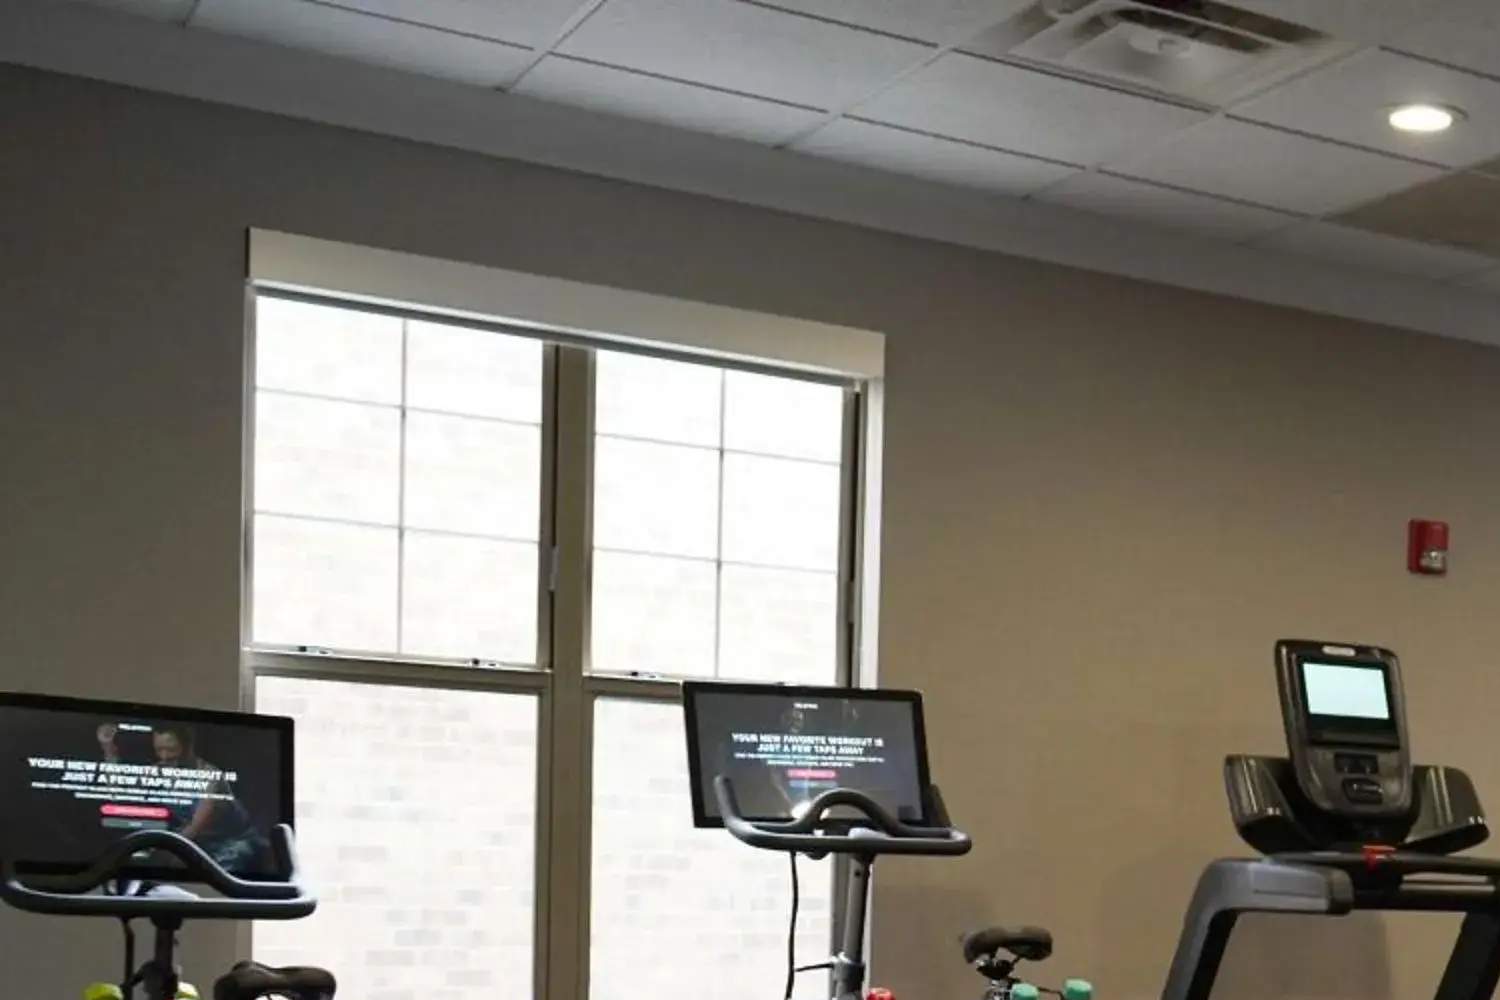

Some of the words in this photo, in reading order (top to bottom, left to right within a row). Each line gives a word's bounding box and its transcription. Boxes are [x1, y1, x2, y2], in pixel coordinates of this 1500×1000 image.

[731, 732, 759, 743] YOUR
[760, 733, 781, 743] NEW
[783, 735, 826, 745] FAVORITE
[828, 736, 872, 747] WORKOUT
[757, 743, 781, 753] JUST
[783, 744, 791, 753] A
[792, 744, 812, 754] FEW
[813, 745, 837, 755] TAPS
[838, 747, 864, 756] AWAY
[27, 757, 64, 770] YOUR
[66, 760, 97, 772] NEW
[99, 762, 159, 777] FAVORITE
[161, 767, 222, 781] WORKOUT
[224, 771, 237, 782] IS
[61, 771, 95, 783] JUST
[98, 773, 108, 783] A
[109, 774, 138, 785] FEW
[140, 776, 172, 788] TAPS
[174, 779, 209, 791] AWAY
